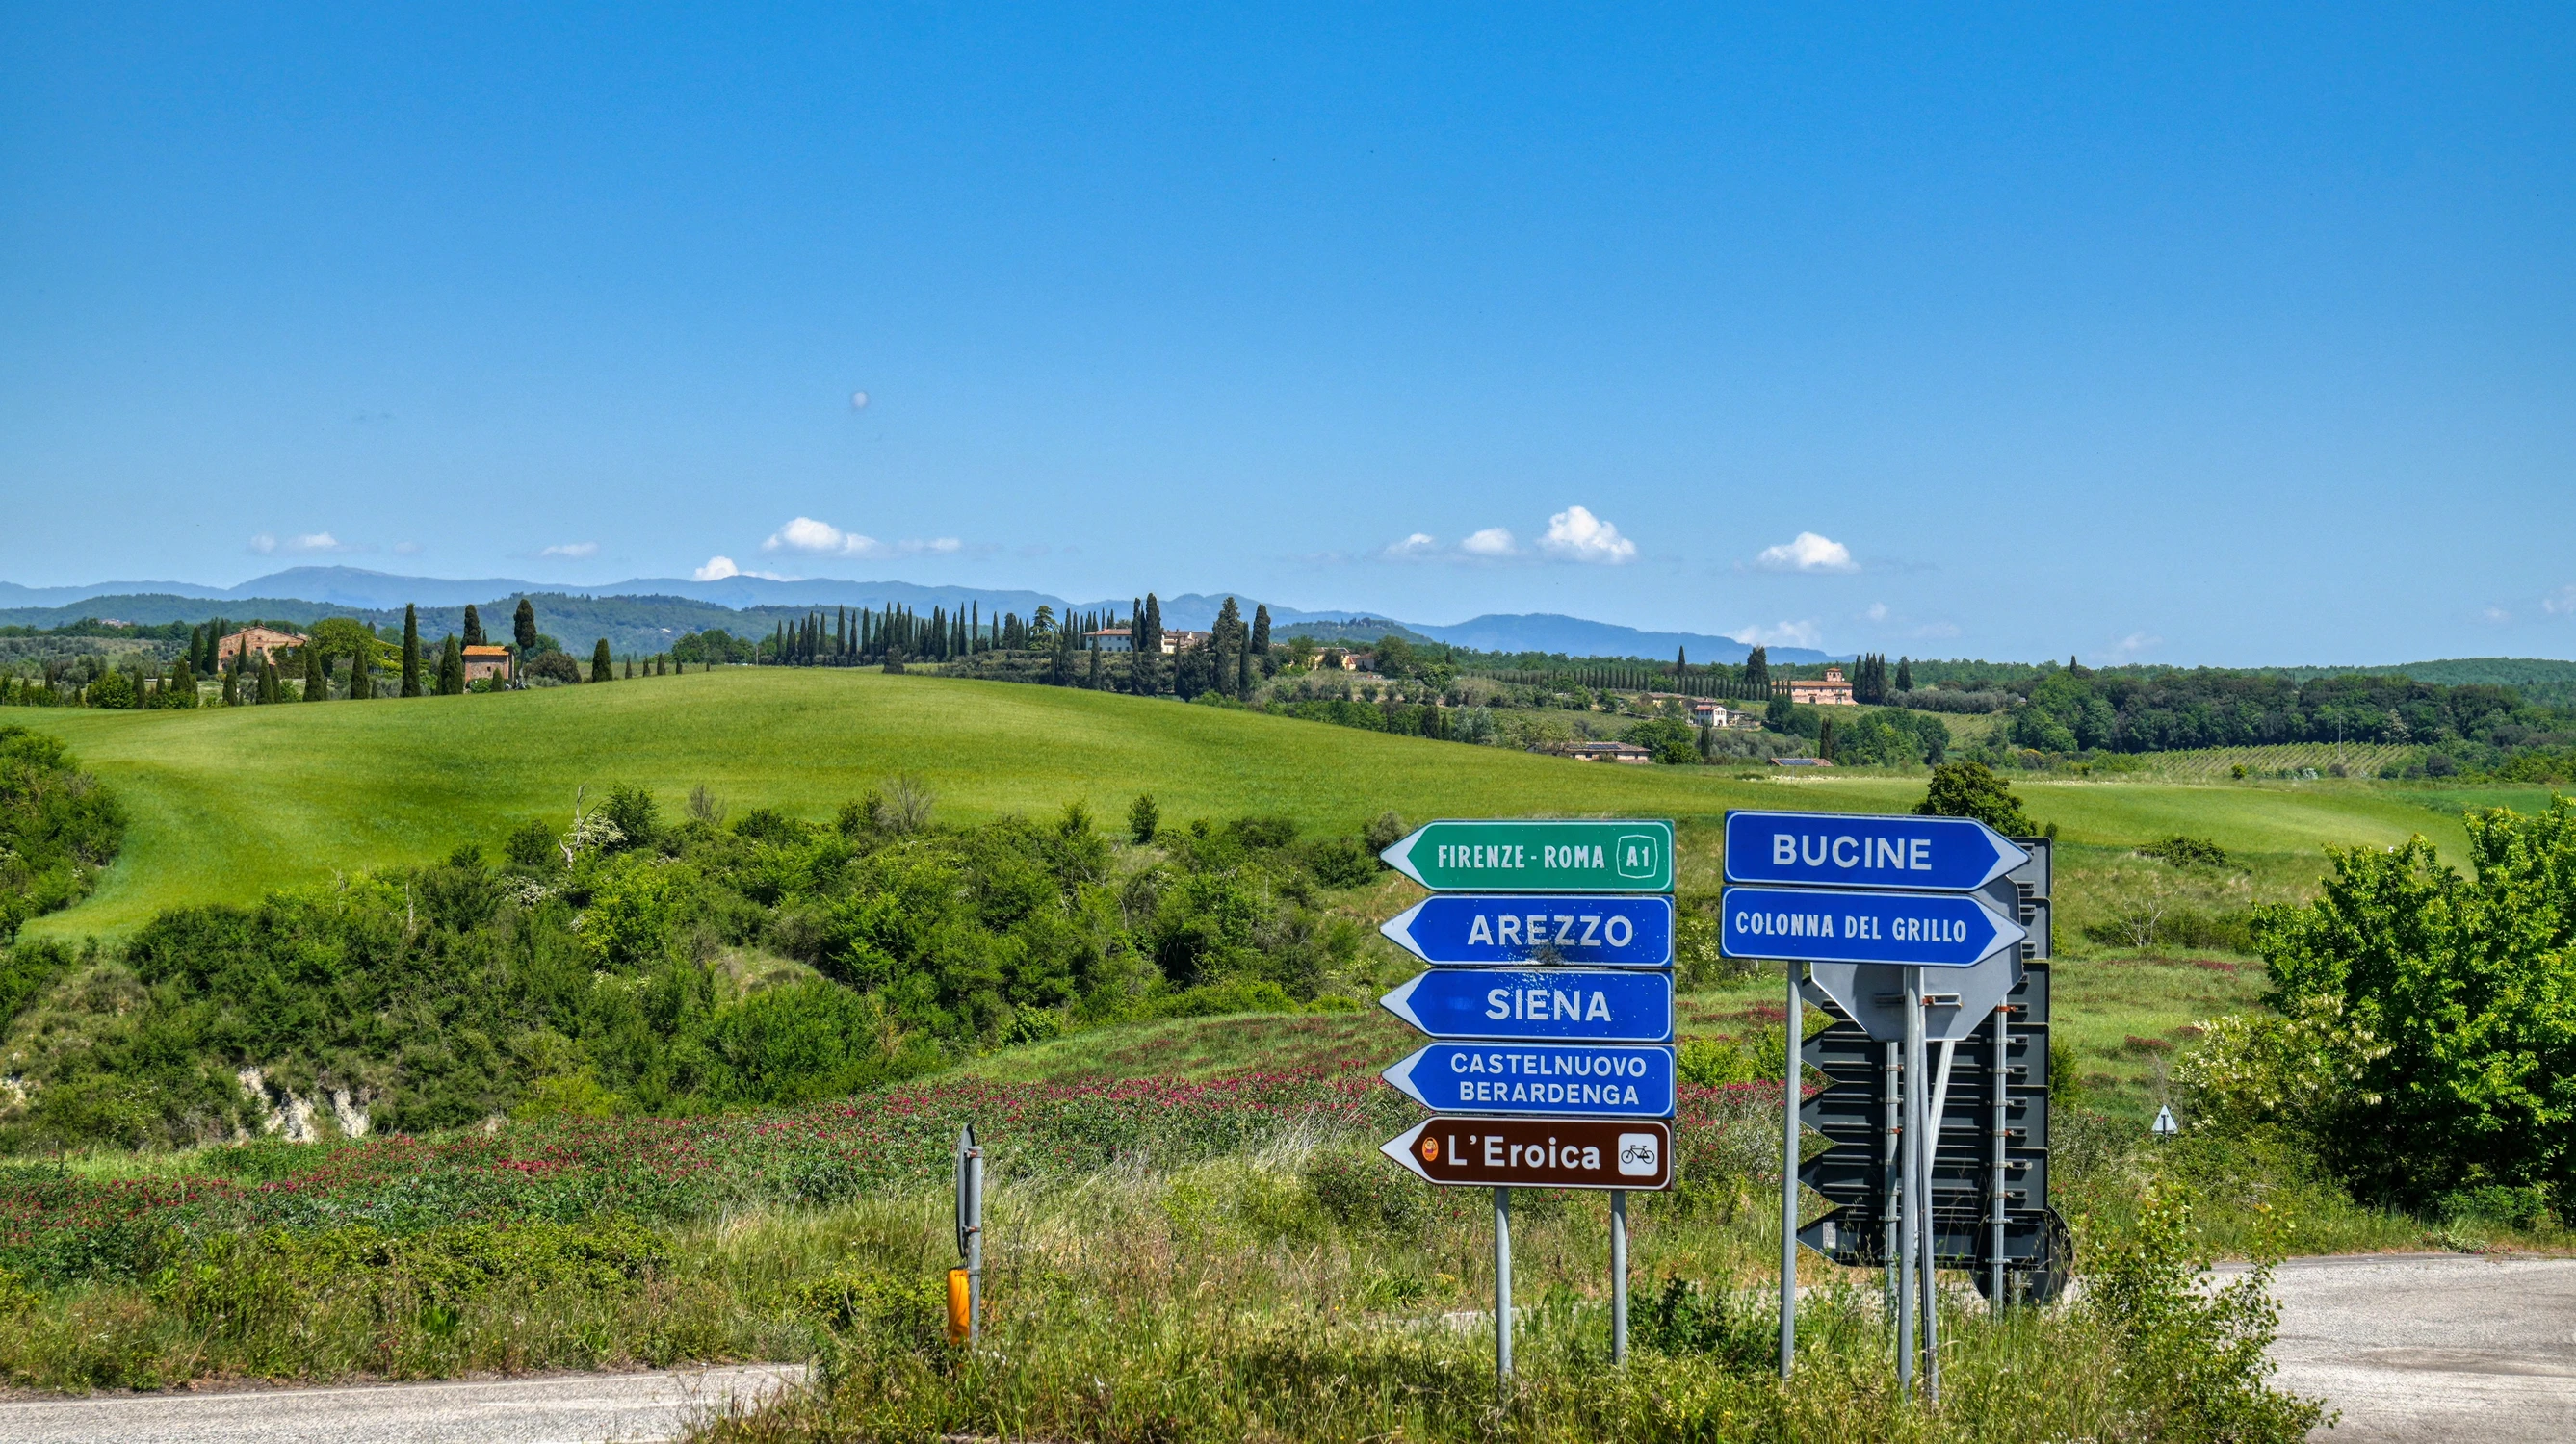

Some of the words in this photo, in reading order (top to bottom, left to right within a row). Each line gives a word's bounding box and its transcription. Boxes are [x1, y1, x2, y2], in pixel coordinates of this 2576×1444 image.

[1438, 844, 1525, 868] FIRENZE
[1545, 845, 1604, 869] ROMA
[1626, 846, 1649, 867] A1
[1773, 834, 1932, 871] BUCINE
[1468, 915, 1633, 948] AREZZO
[1735, 911, 1834, 939] COLONNA
[1845, 915, 1880, 940] DEL
[1892, 917, 1966, 942] GRILLO
[1485, 989, 1611, 1022] SIENA
[1450, 1052, 1646, 1077] CASTELNUOVO
[1460, 1082, 1639, 1105] BERARDENGA
[1448, 1134, 1600, 1170] L'Eroica
